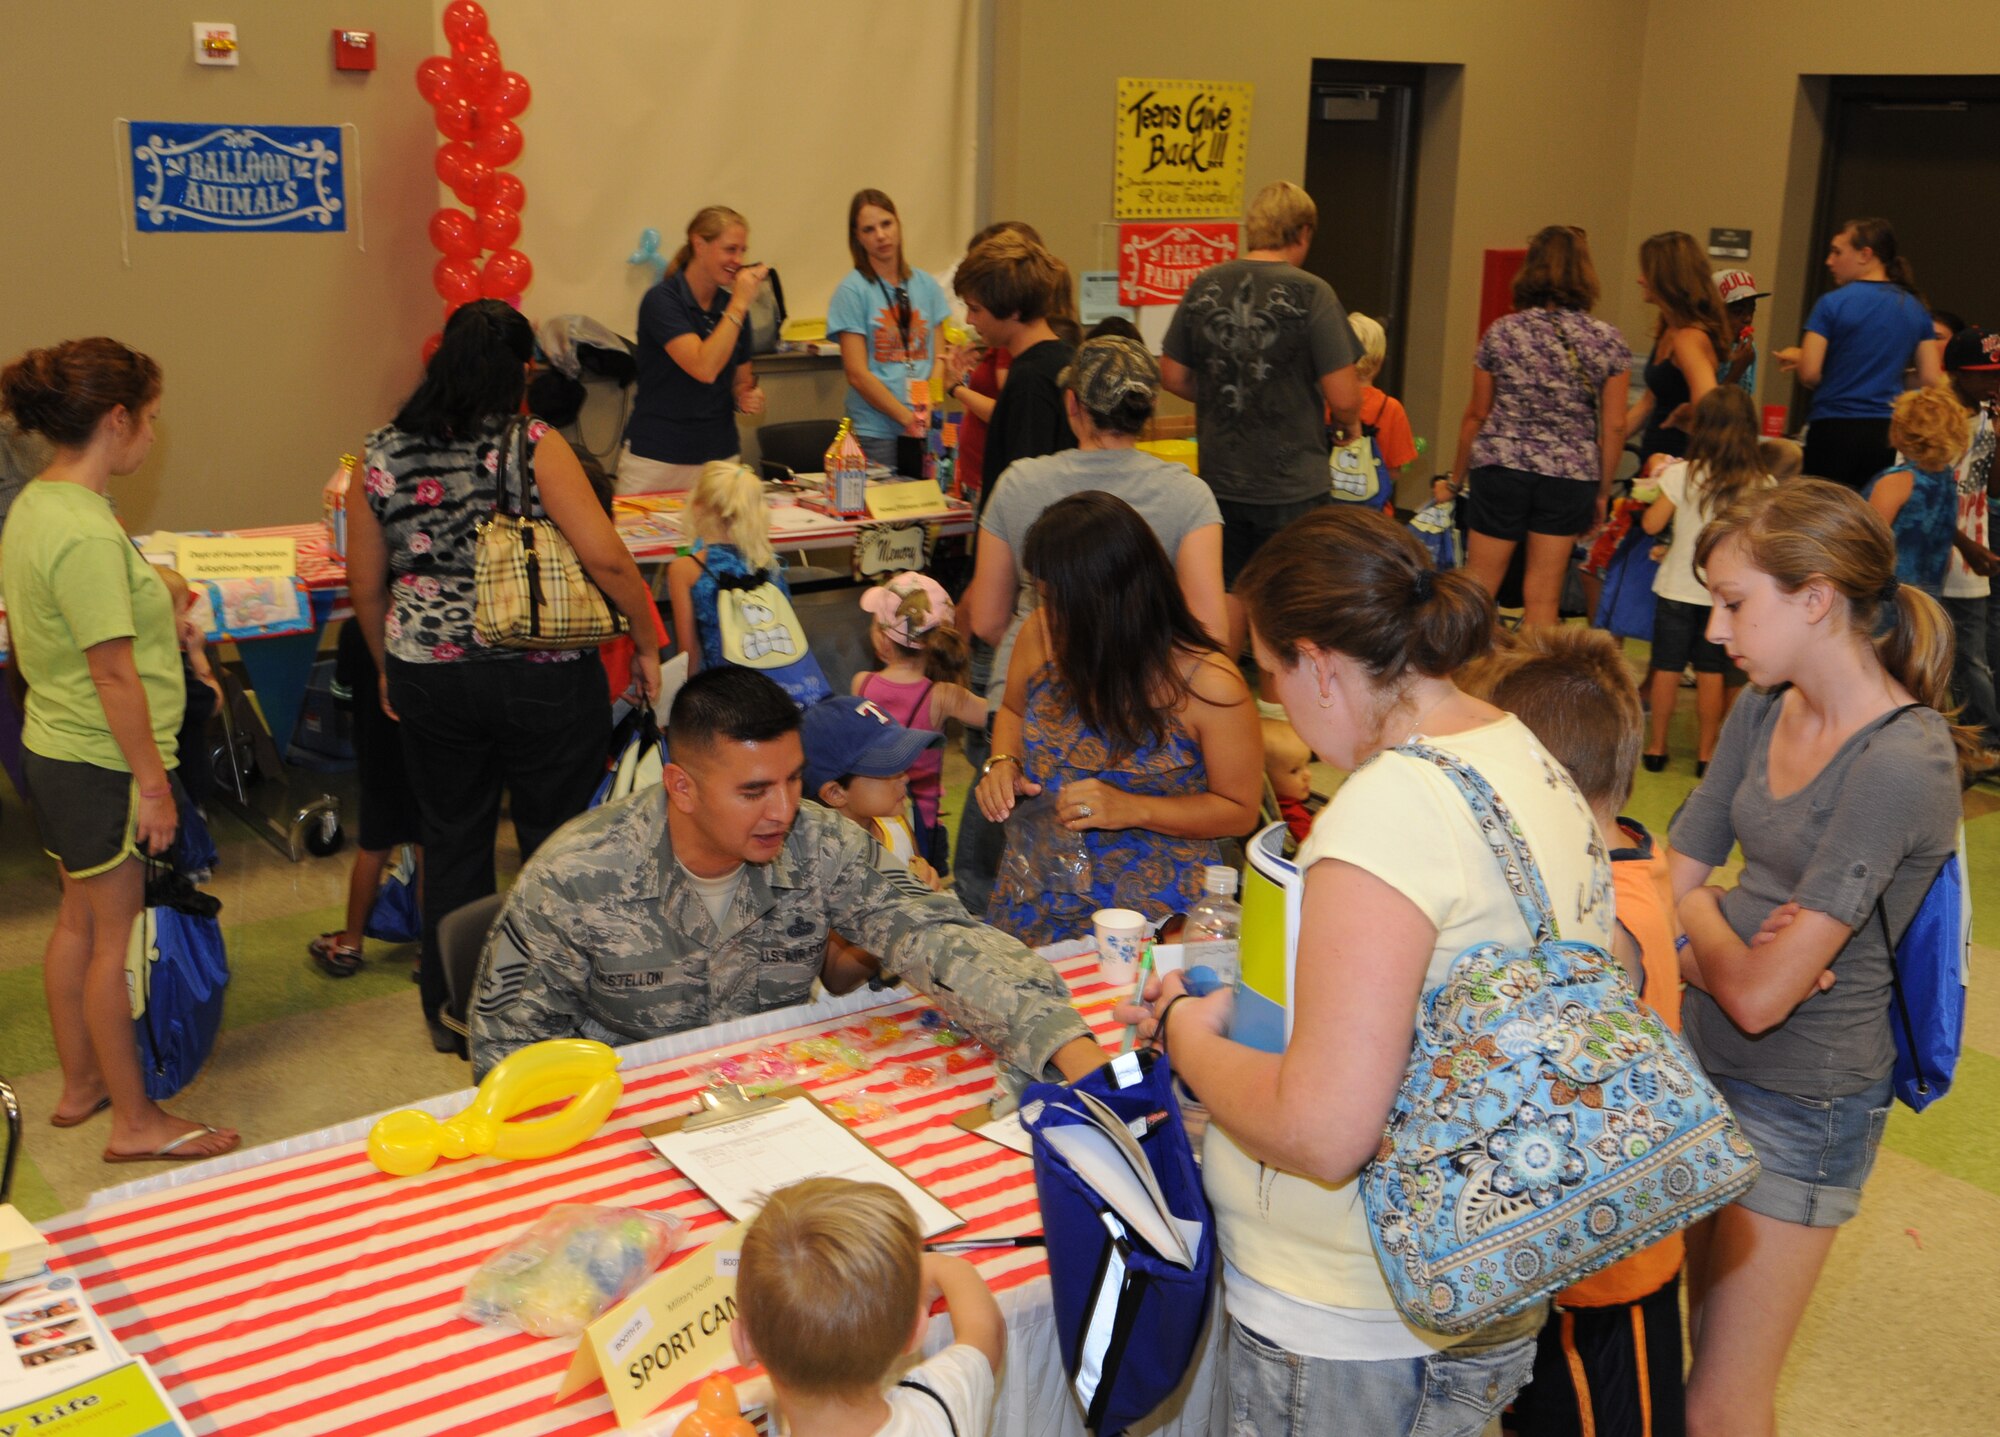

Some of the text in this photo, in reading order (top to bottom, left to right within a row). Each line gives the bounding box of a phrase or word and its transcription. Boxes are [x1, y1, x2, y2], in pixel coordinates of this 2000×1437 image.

[1128, 91, 1232, 138] Teens Give
[189, 151, 291, 185] BALLOON
[183, 180, 298, 216] ANIMALS
[1162, 244, 1201, 266] FACE
[1143, 262, 1206, 290] PAINT
[855, 700, 891, 725] T
[723, 1258, 740, 1267] BOOT
[667, 1275, 715, 1313] Military Youth
[629, 1322, 697, 1390] SPORT
[30, 1394, 99, 1427] Life
